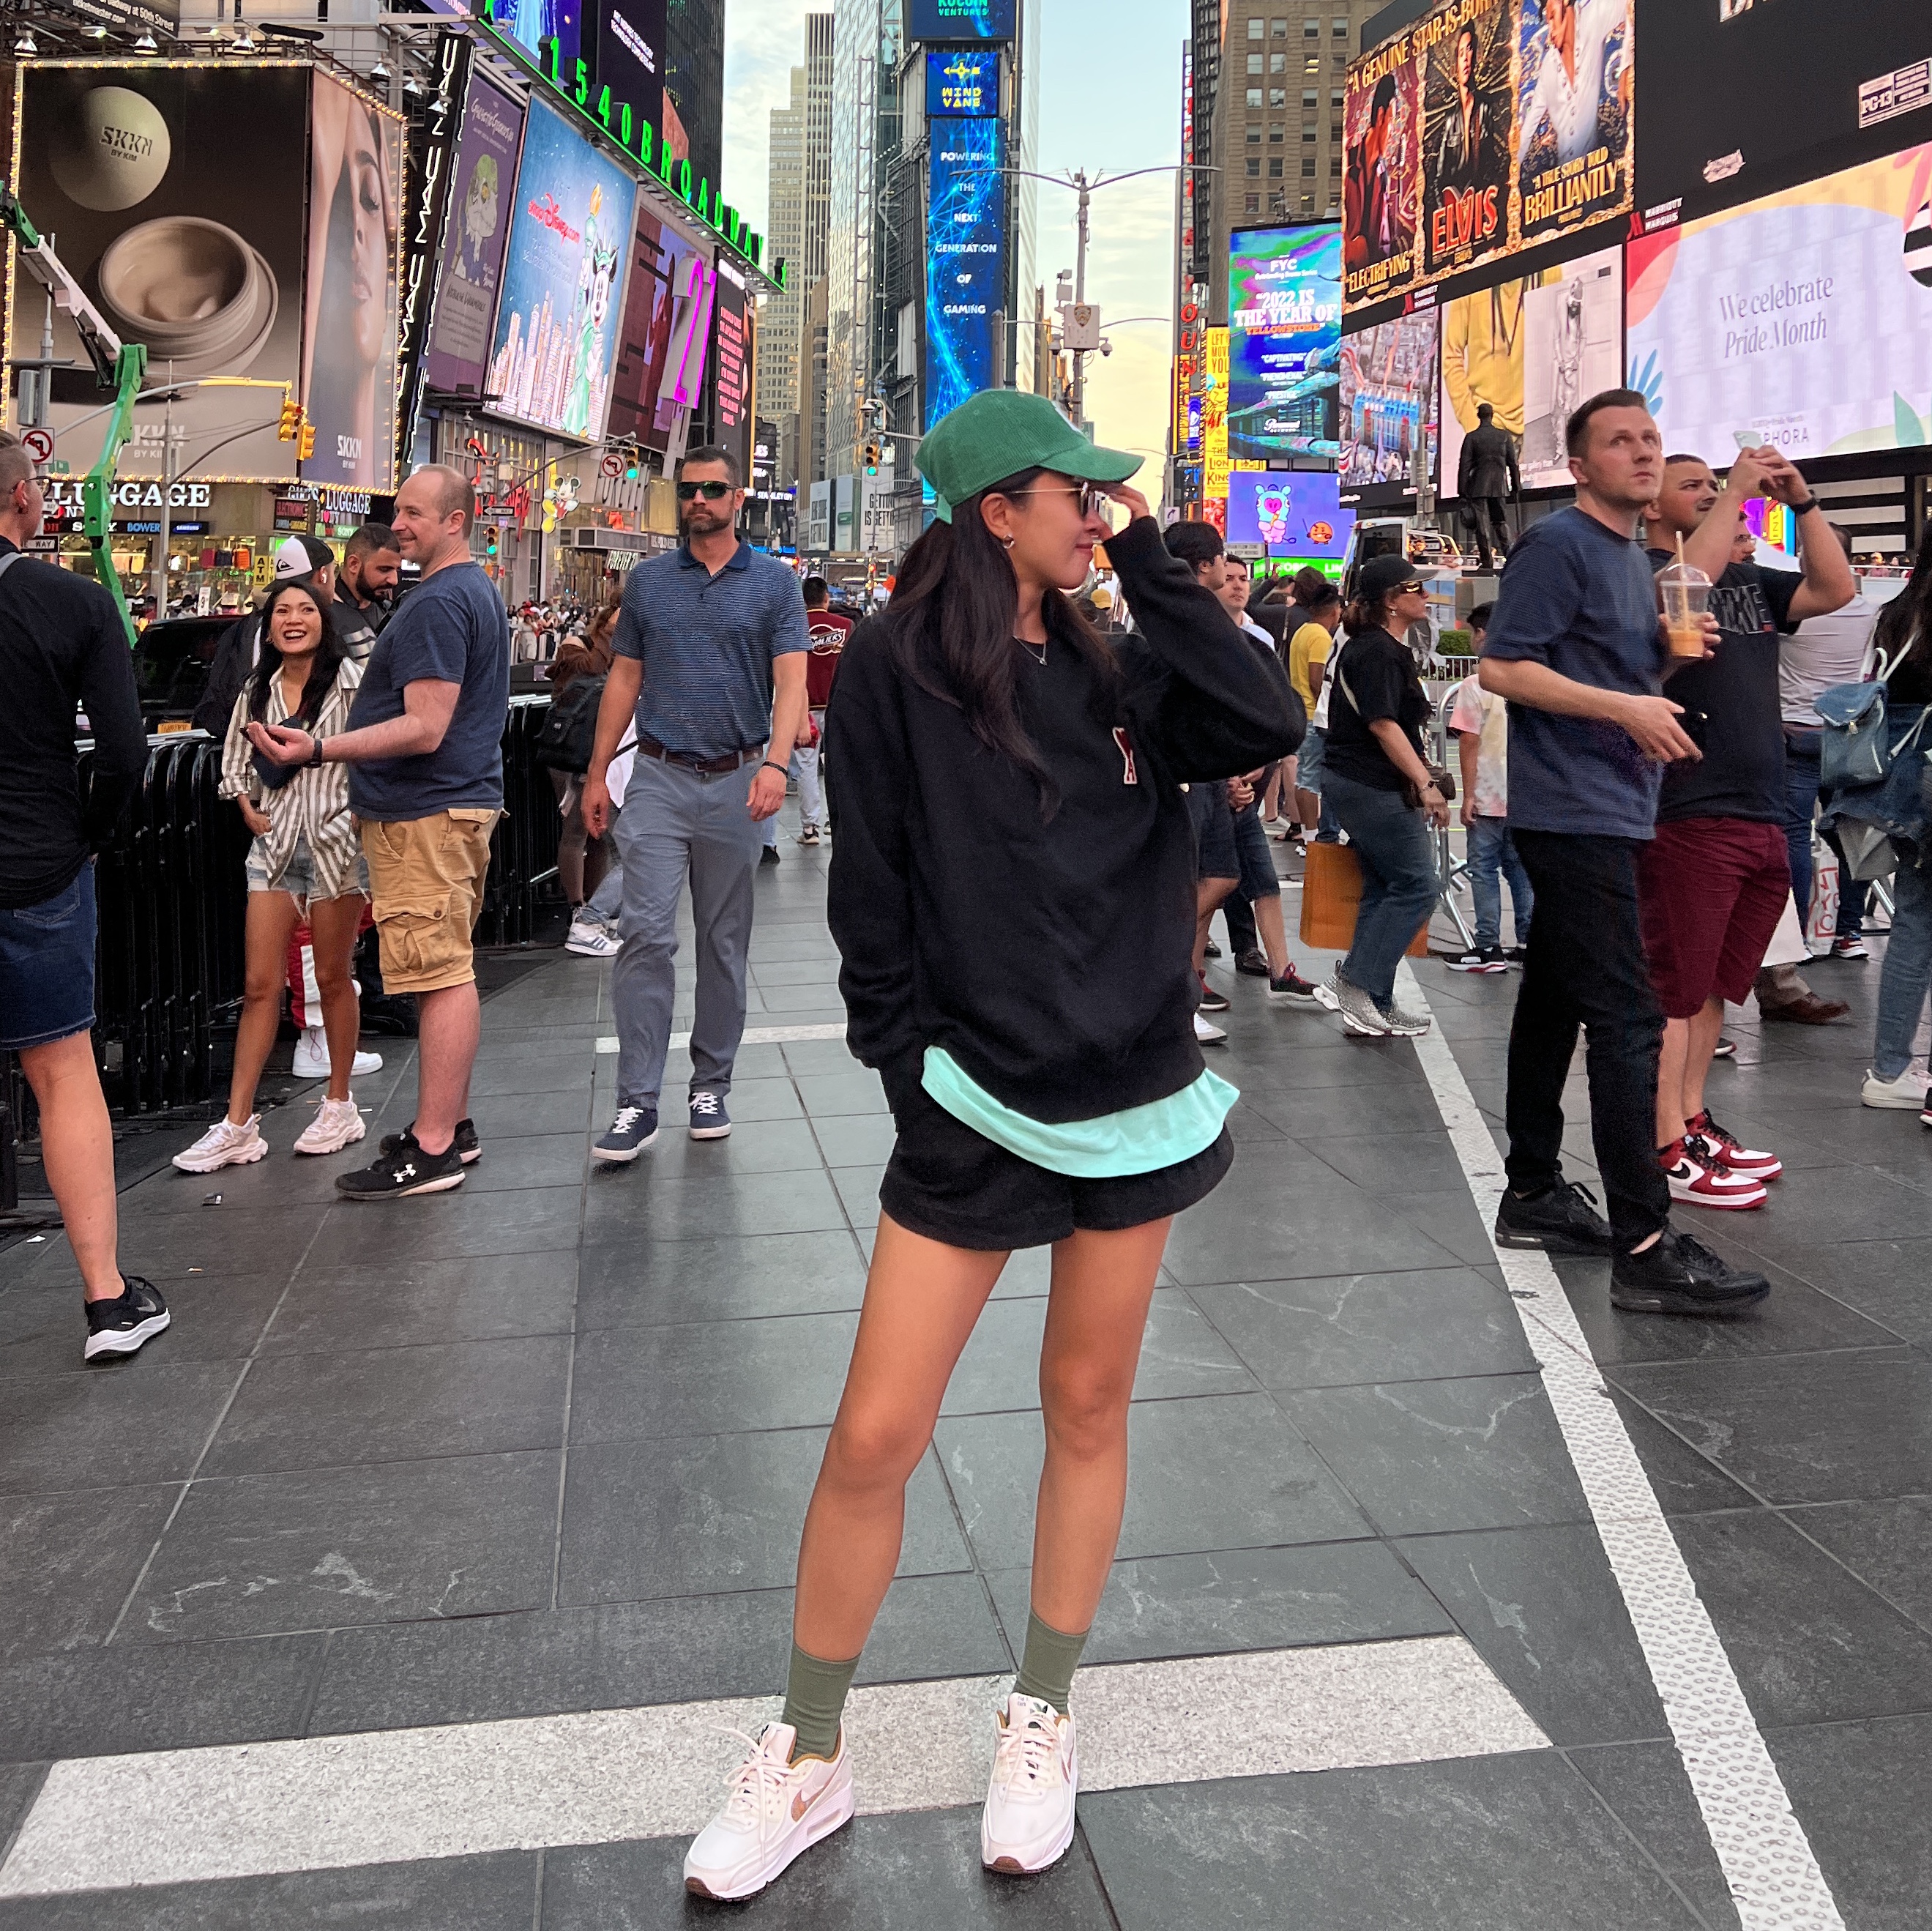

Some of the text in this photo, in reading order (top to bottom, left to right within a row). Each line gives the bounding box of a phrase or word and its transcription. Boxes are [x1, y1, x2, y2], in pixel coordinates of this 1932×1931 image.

[938, 7, 989, 16] VENTURES
[132, 7, 139, 17] at
[139, 7, 154, 23] 50th
[154, 13, 174, 31] Street
[1362, 36, 1410, 88] GENUINE
[941, 87, 982, 97] WIND
[942, 97, 981, 108] VANE
[1861, 90, 1892, 115] PG-13
[100, 126, 153, 157] SKKN
[111, 149, 138, 162] BY KIM
[940, 152, 994, 162] POWERING
[958, 183, 976, 193] THE
[953, 212, 979, 223] NEXT
[1432, 185, 1499, 256] ELVIS
[934, 243, 997, 253] GENERATION
[1269, 258, 1298, 272] FYC
[956, 273, 972, 284] OF
[1298, 289, 1315, 307] IS
[1719, 277, 1834, 321] We celebrate
[943, 304, 986, 315] GAMING
[1234, 302, 1338, 327] THE YEAR OF
[1212, 334, 1224, 345] LET
[1724, 311, 1827, 359] Pride Month
[337, 434, 362, 459] SKKN
[133, 450, 147, 458] BY
[326, 489, 371, 515] LUGGAGE
[865, 510, 872, 526] IS
[127, 523, 160, 532] BOWER
[36, 540, 52, 548] WAY
[256, 557, 266, 583] ATM
